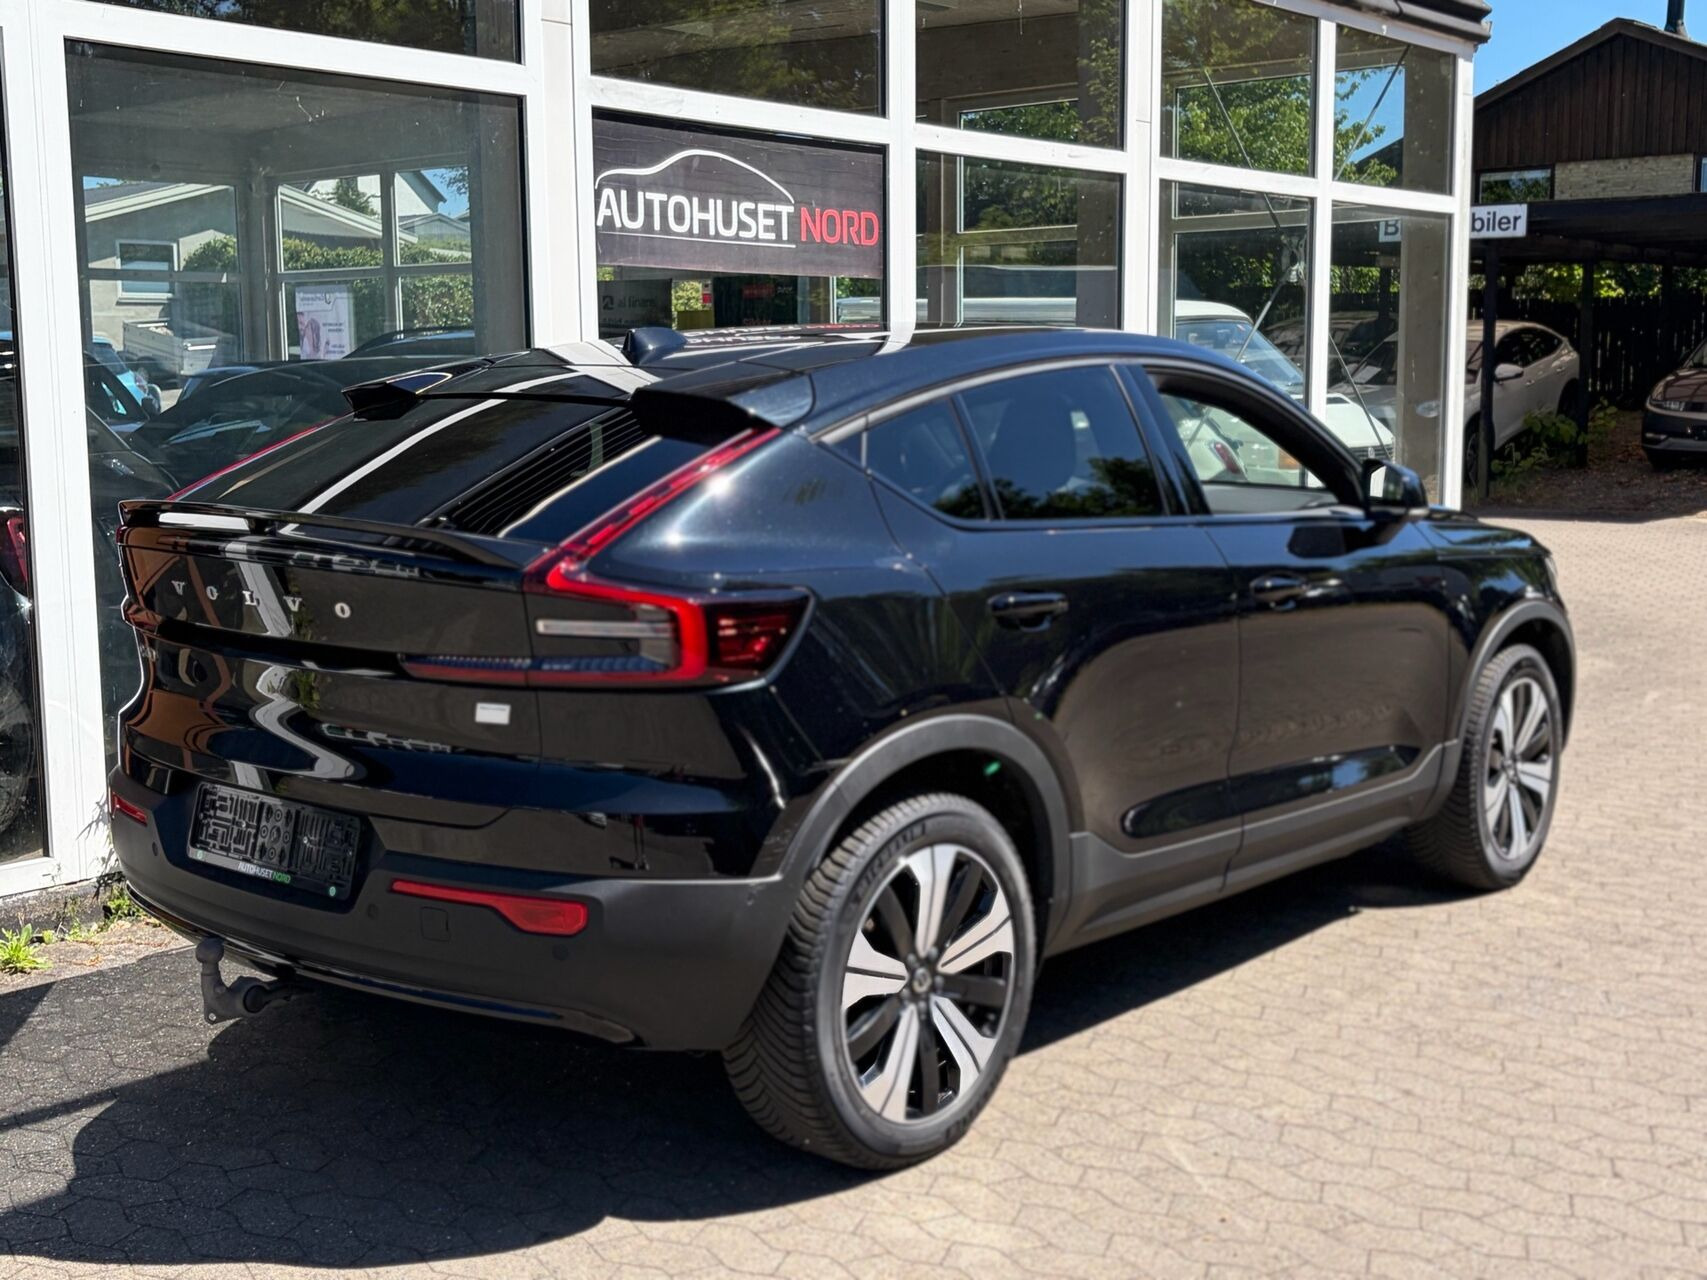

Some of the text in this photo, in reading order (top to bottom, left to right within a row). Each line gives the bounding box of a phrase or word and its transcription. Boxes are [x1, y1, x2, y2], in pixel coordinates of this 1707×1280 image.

[596, 187, 880, 246] AUTOHUSET NORD
[171, 580, 352, 619] VOLVO
[237, 861, 291, 884] AUTOHUSET NORD
